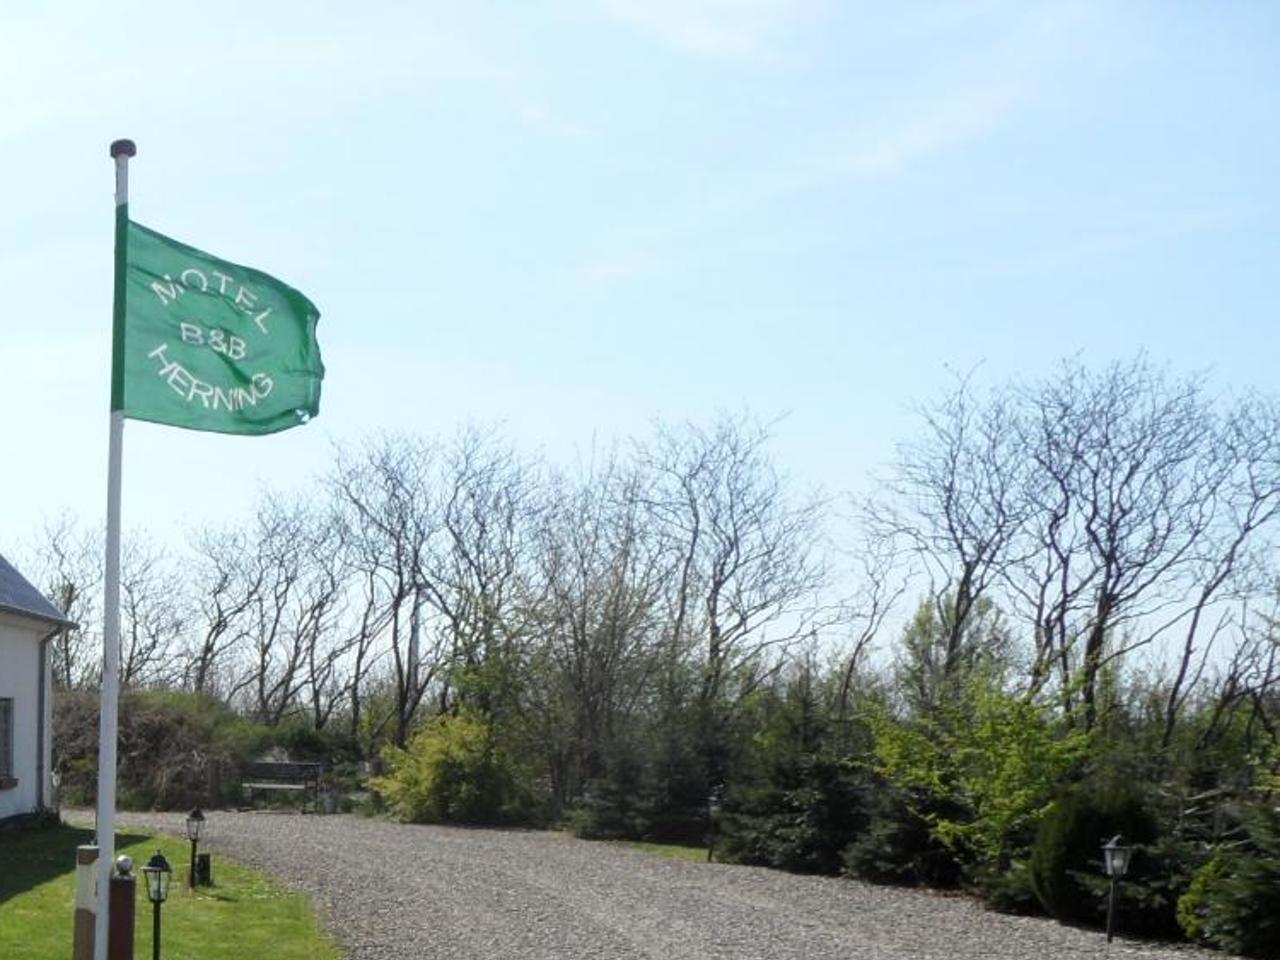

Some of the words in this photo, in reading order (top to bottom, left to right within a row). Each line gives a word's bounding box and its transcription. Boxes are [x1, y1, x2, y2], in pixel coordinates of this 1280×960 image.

[150, 268, 273, 334] MOTEL
[180, 322, 246, 360] B&B
[148, 344, 274, 411] HERNING
